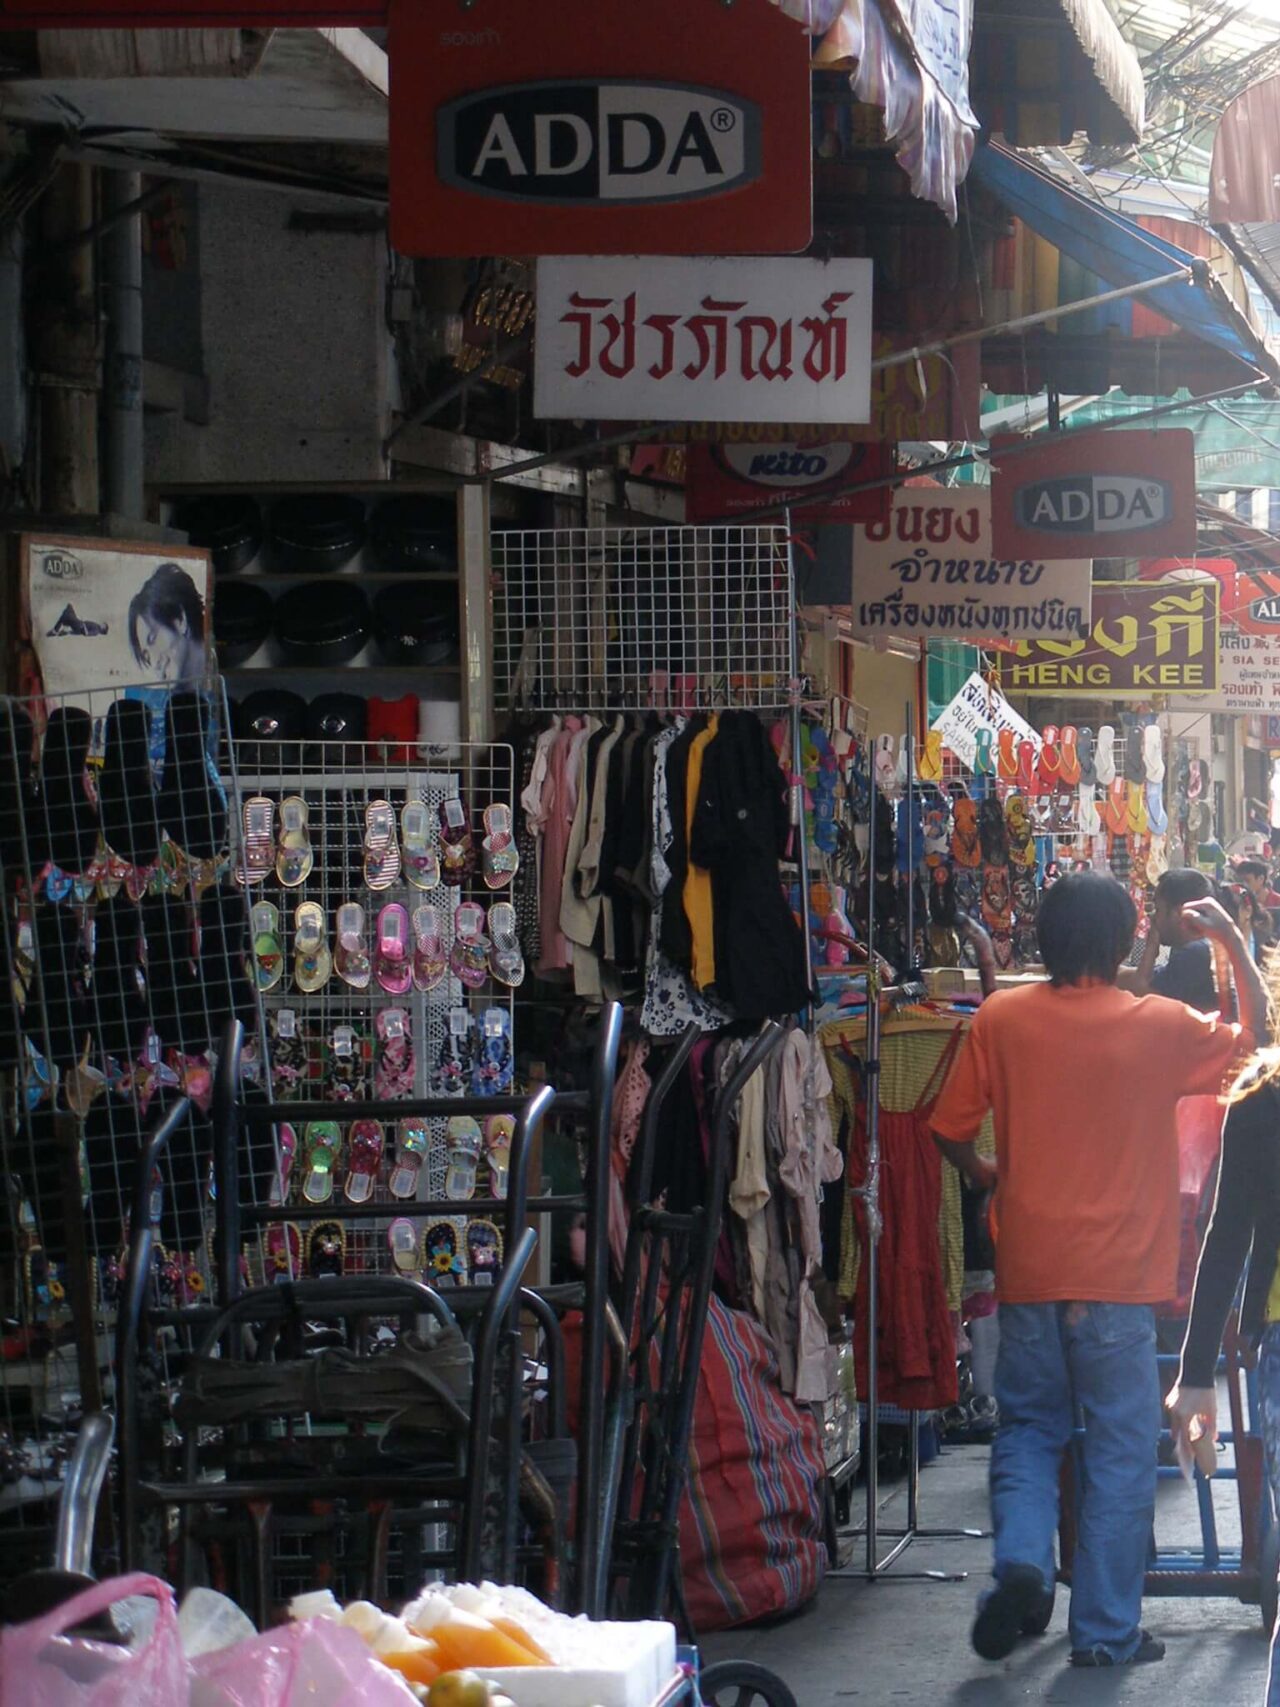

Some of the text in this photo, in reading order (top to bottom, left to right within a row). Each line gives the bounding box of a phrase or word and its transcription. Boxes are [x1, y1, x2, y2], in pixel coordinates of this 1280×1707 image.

[1233, 655, 1254, 665] SIA
[1012, 663, 1204, 685] HENG KEE
[1221, 679, 1263, 697] รองเท้า
